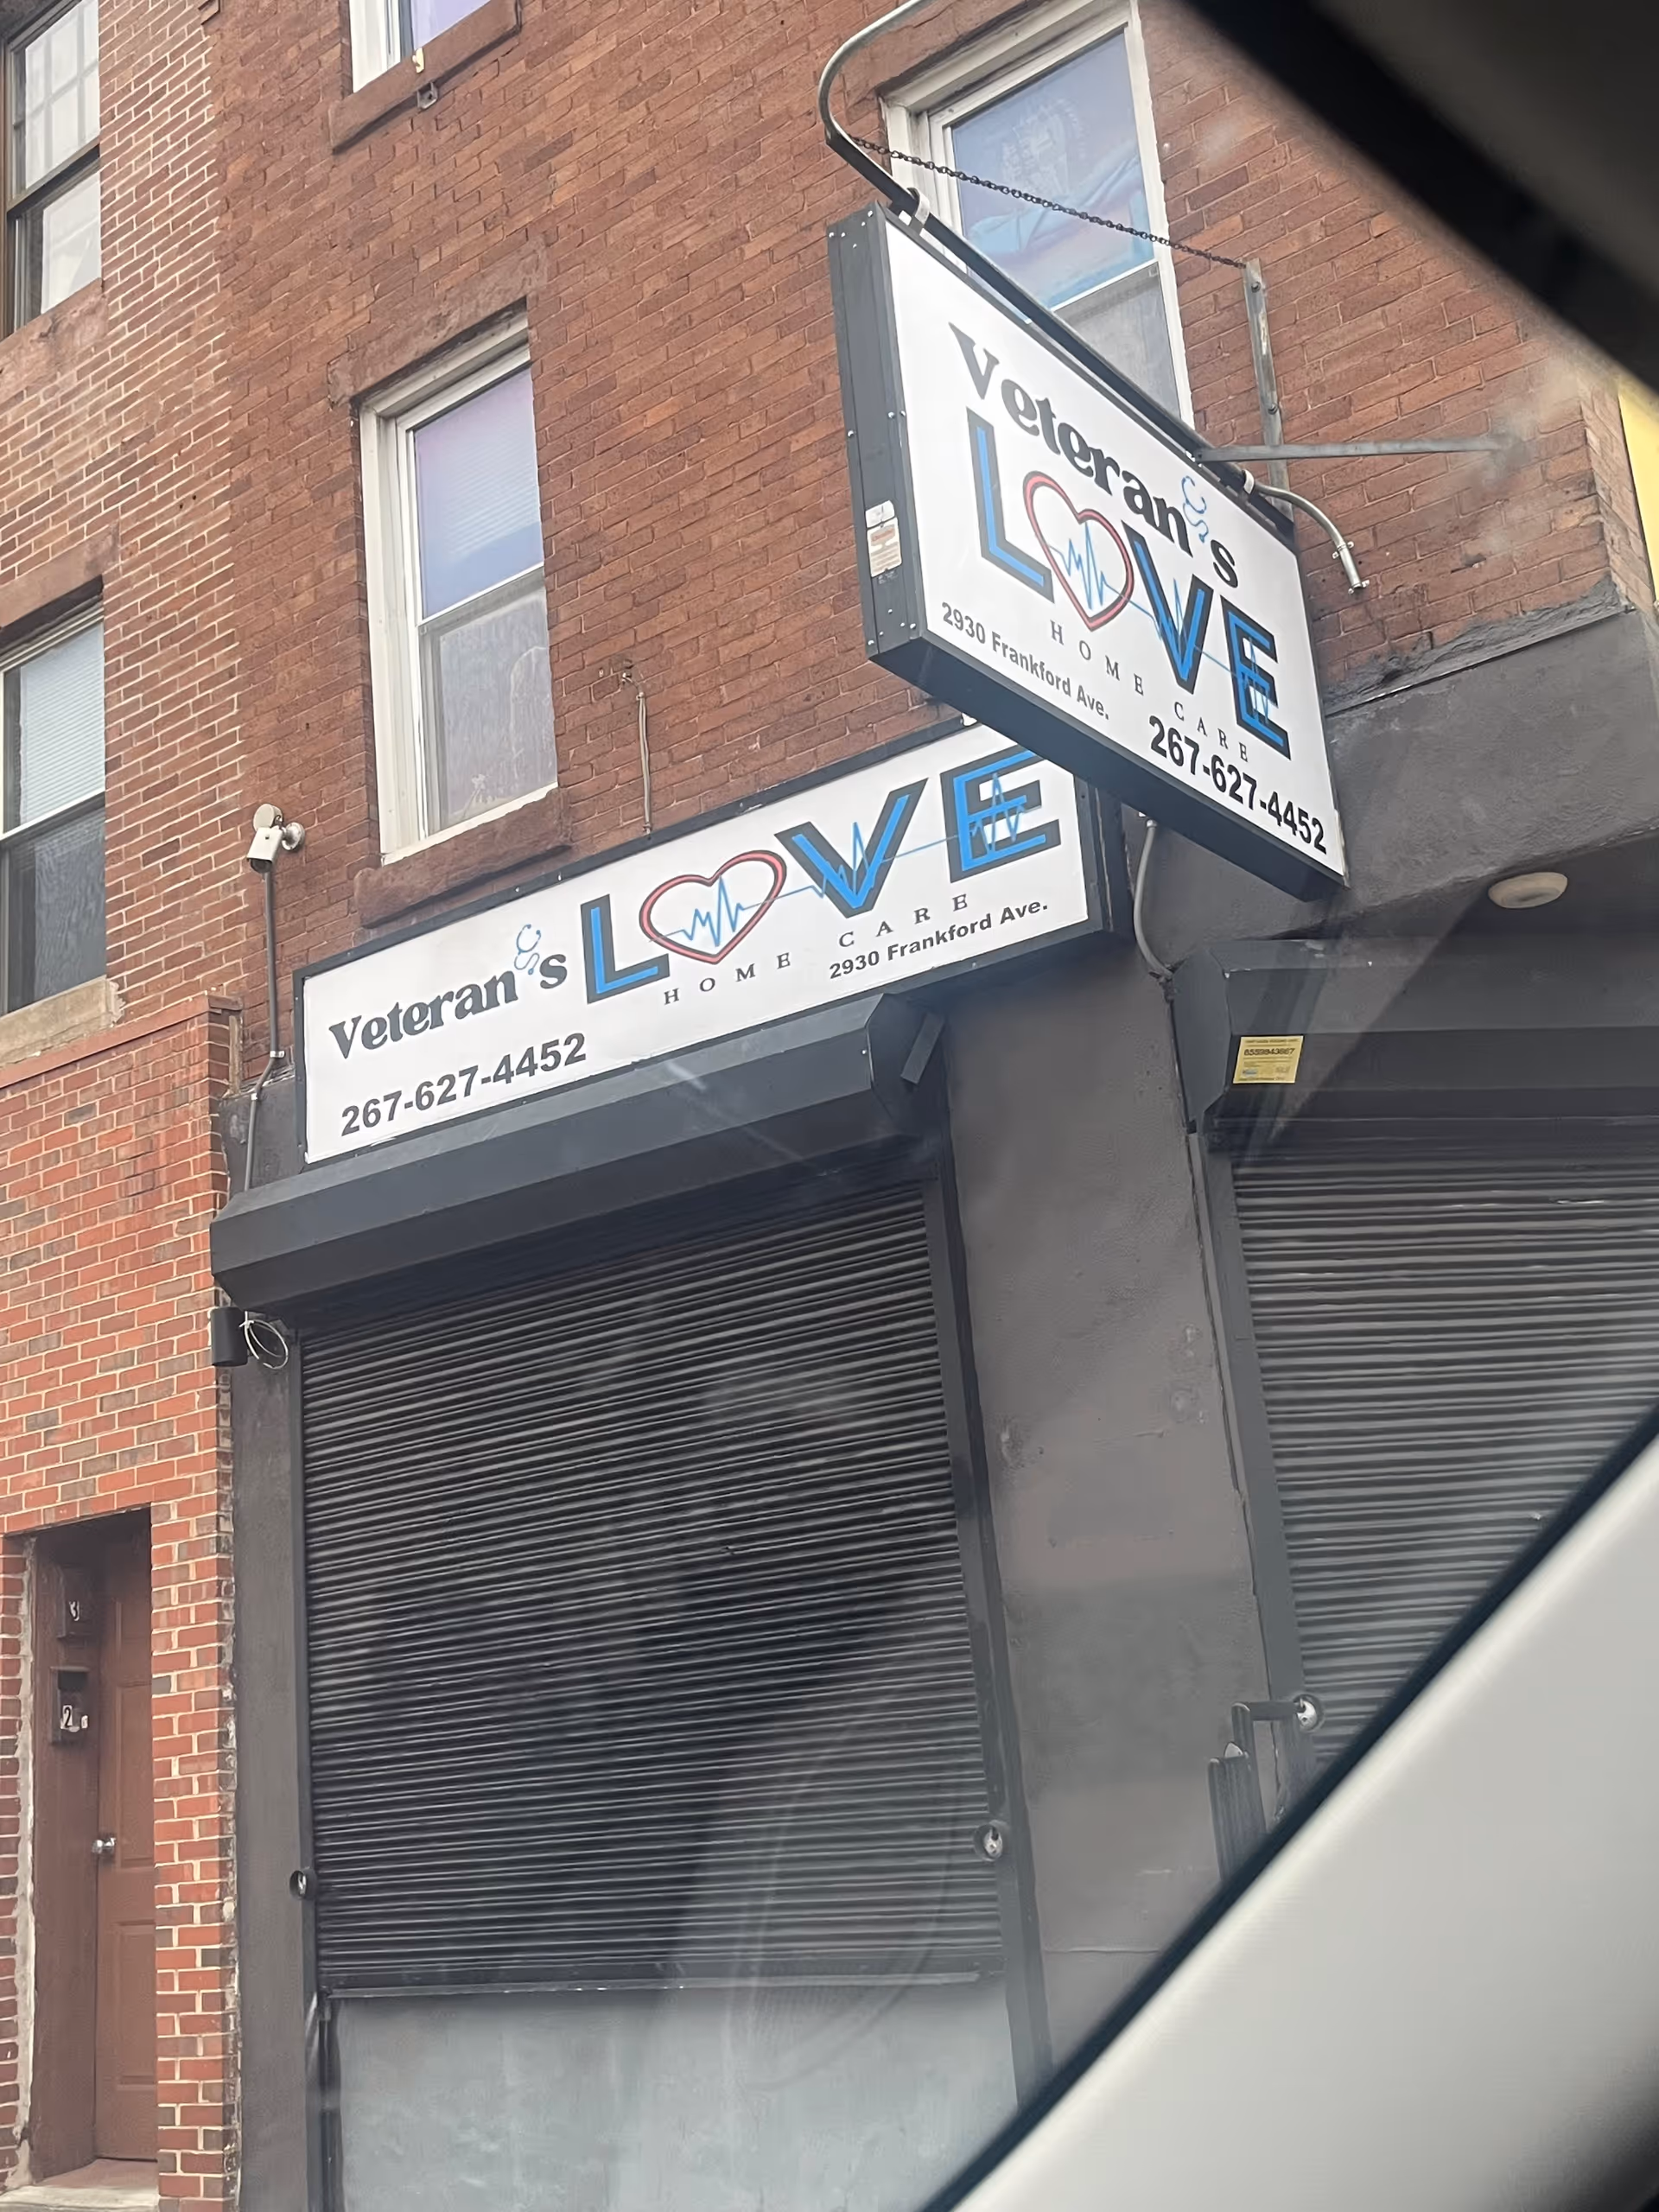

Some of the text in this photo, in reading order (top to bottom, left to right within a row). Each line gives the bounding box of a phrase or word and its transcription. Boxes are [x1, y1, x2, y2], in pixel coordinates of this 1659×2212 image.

[948, 321, 1239, 588] Veteran's
[941, 601, 1109, 720] 2930 Frankford Ave.
[1049, 619, 1249, 763] HOME CARE
[1148, 715, 1327, 855] 267-627-4452
[328, 924, 569, 1060] Veteran's
[663, 893, 969, 1006] HOME CARE
[829, 899, 1049, 980] 2930 Frankford Ave.
[340, 1032, 587, 1137] 267-627-4452
